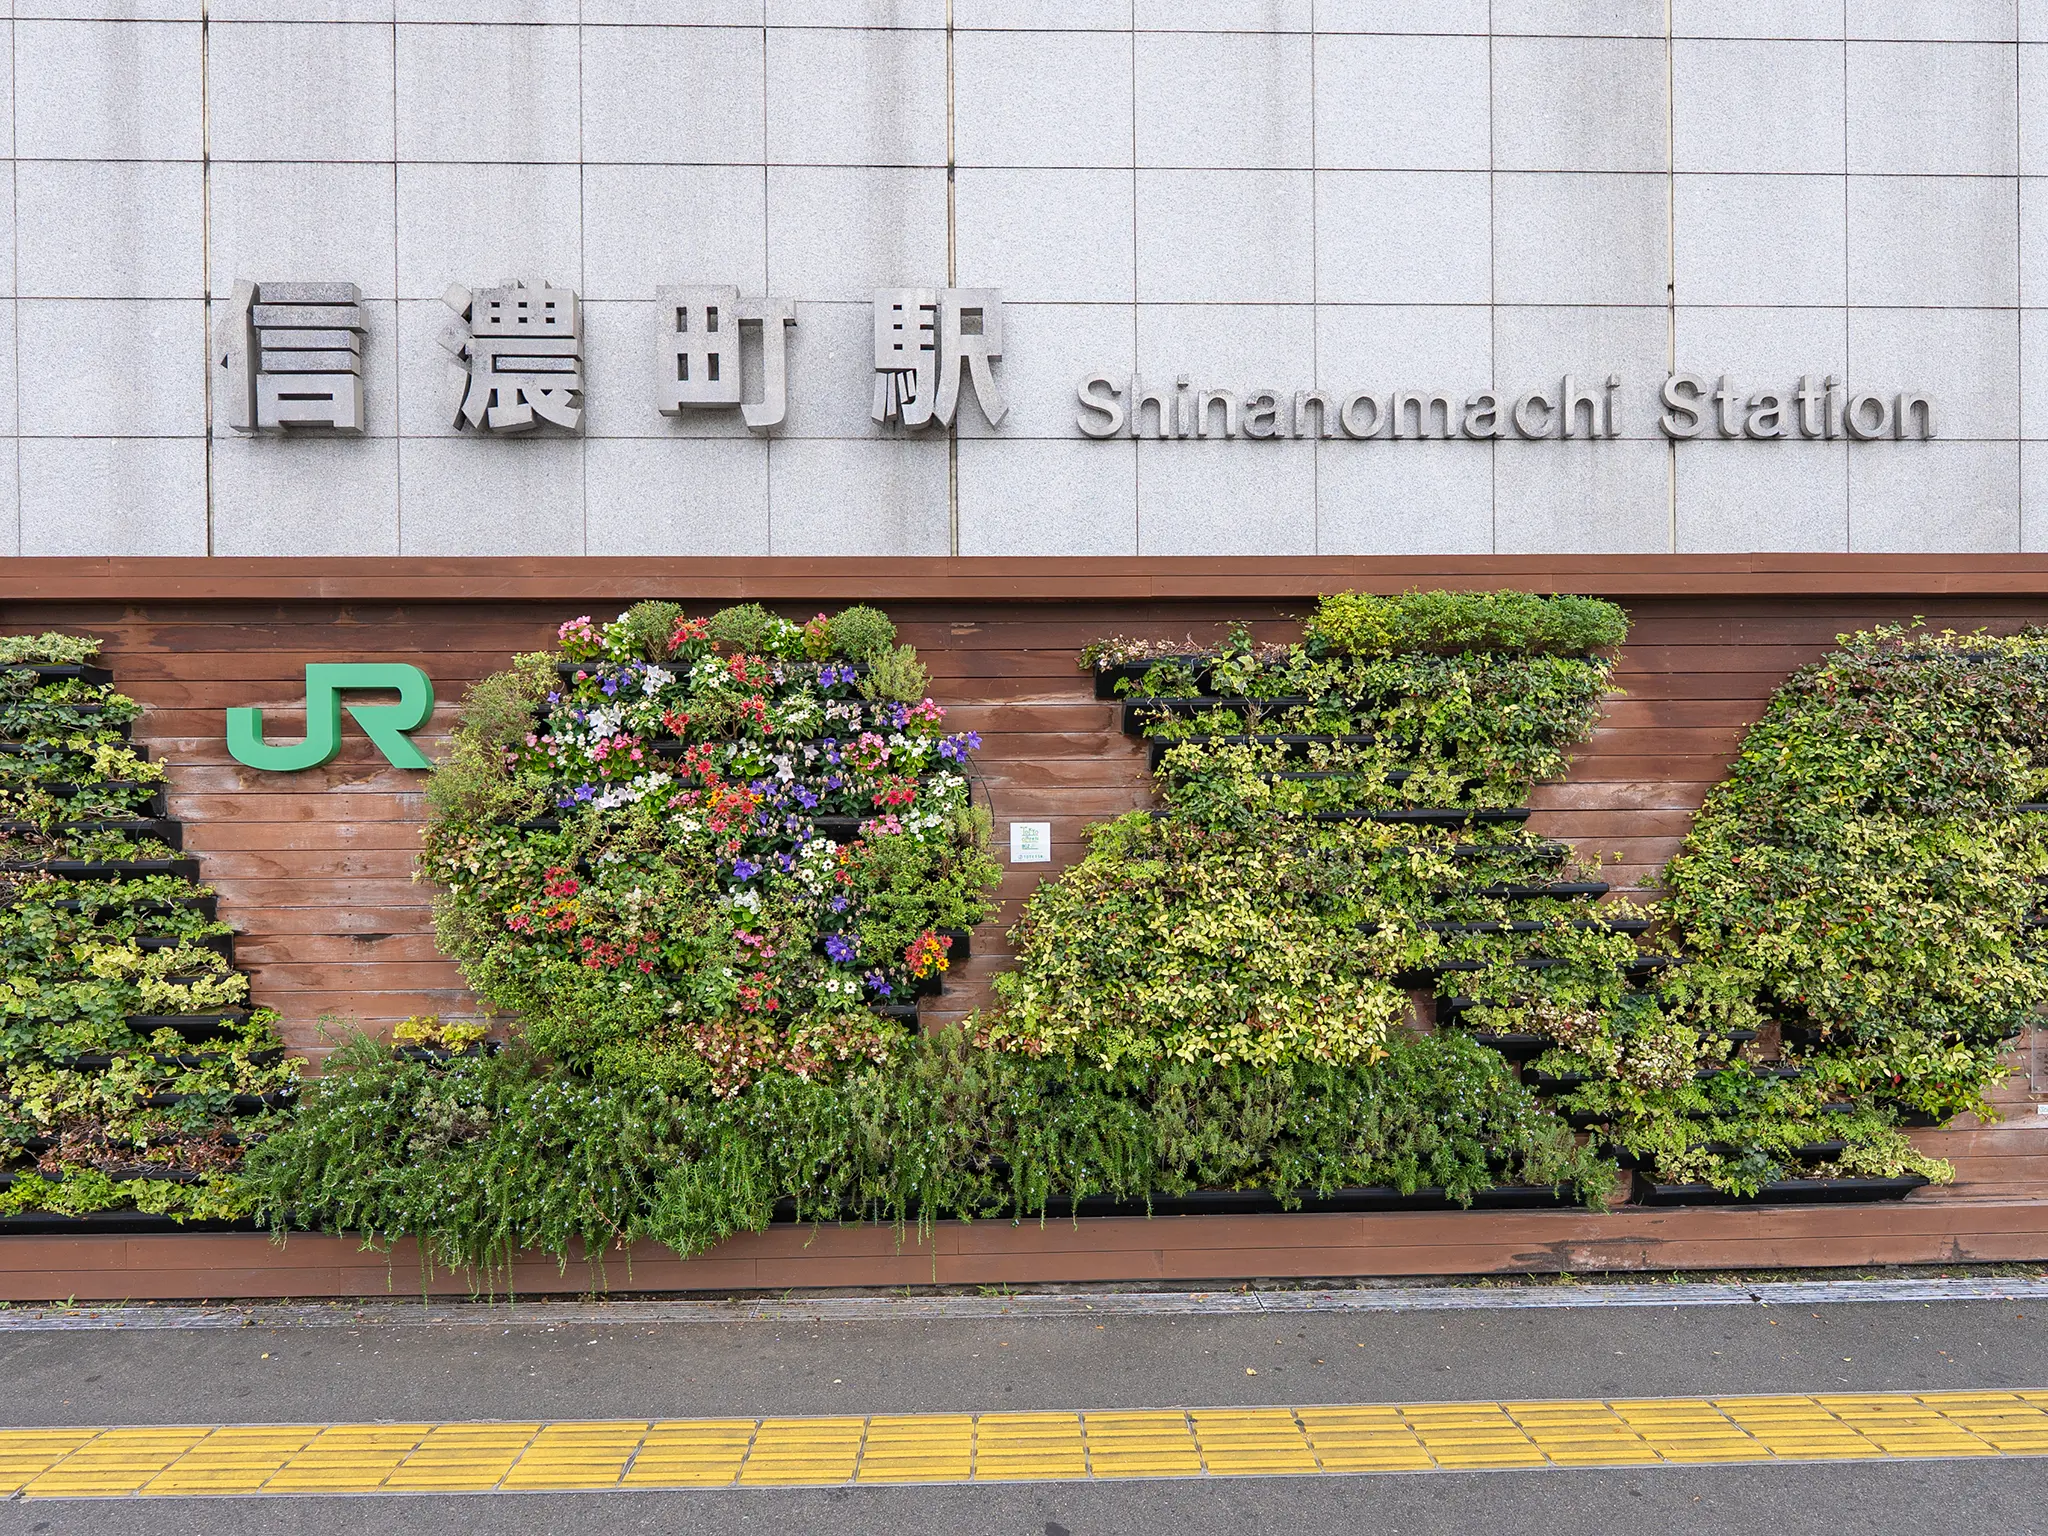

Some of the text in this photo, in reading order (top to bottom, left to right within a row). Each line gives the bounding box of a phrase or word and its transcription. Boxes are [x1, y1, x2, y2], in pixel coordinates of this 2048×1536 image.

[221, 277, 1009, 435] 信濃町駅
[1076, 372, 1938, 439] Shinanomachi Station
[226, 663, 436, 772] JR
